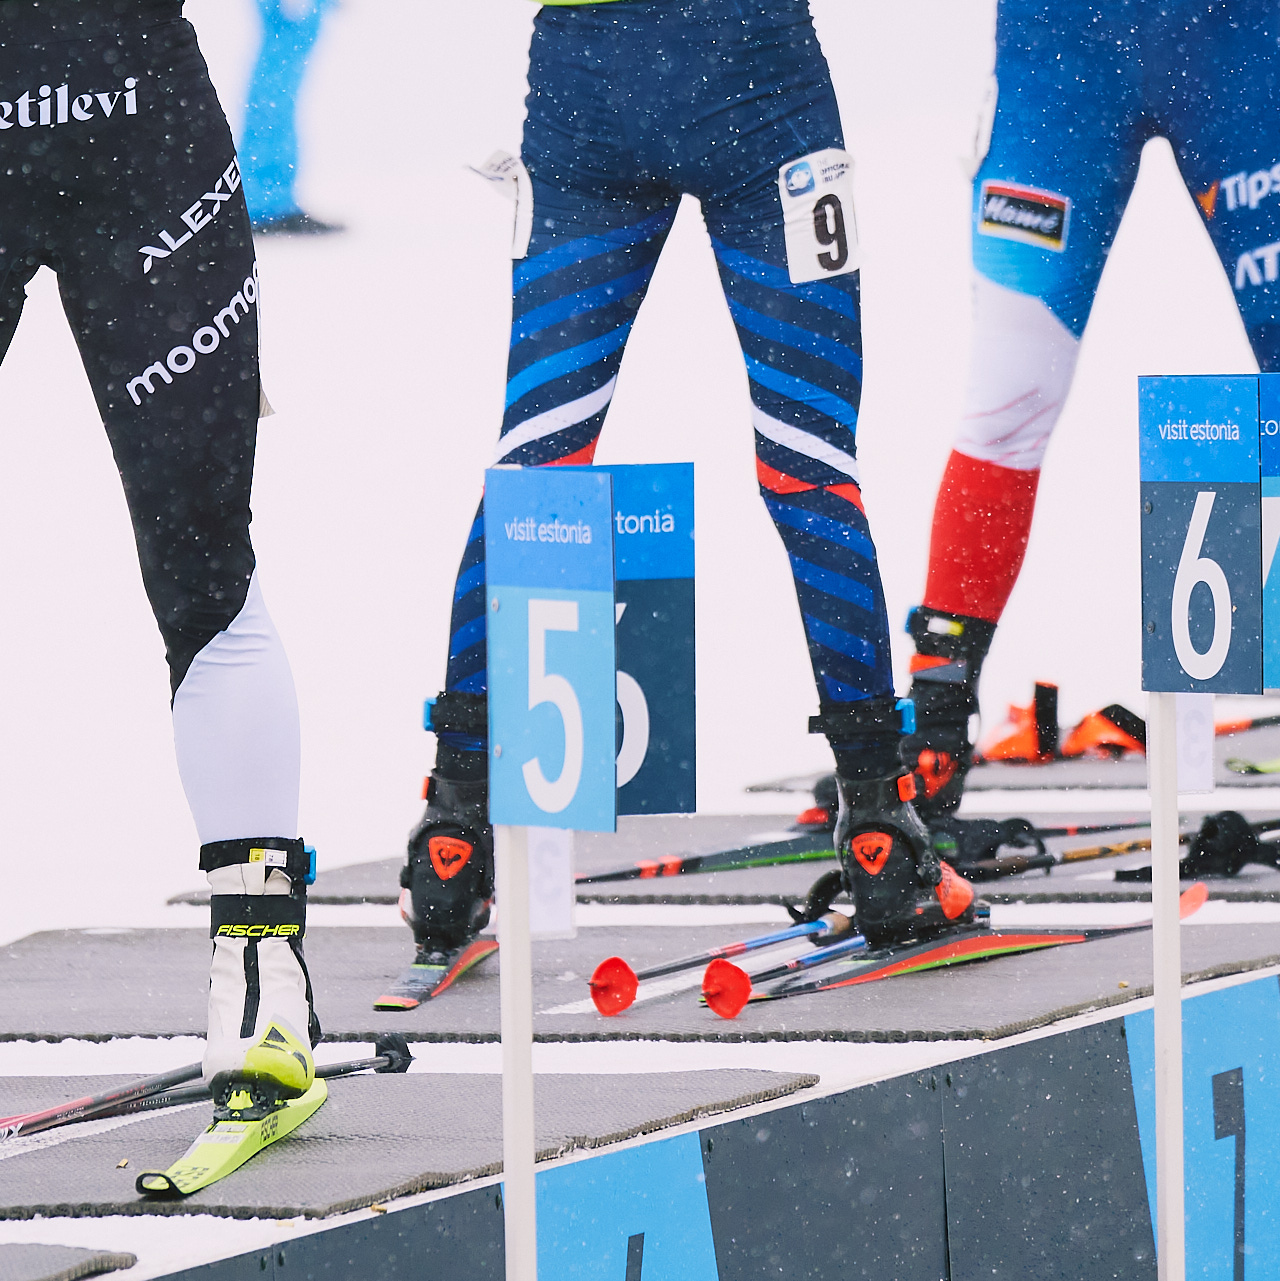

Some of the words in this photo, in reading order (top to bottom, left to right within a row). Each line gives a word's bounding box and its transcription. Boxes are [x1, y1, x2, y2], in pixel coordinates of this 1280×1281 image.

[813, 194, 848, 271] 9
[1159, 419, 1188, 440] visit
[1190, 421, 1240, 442] estonia
[504, 519, 536, 542] visit
[538, 520, 592, 545] estonia
[1171, 491, 1232, 681] 6
[521, 598, 585, 814] 5
[216, 923, 301, 938] FISCHER
